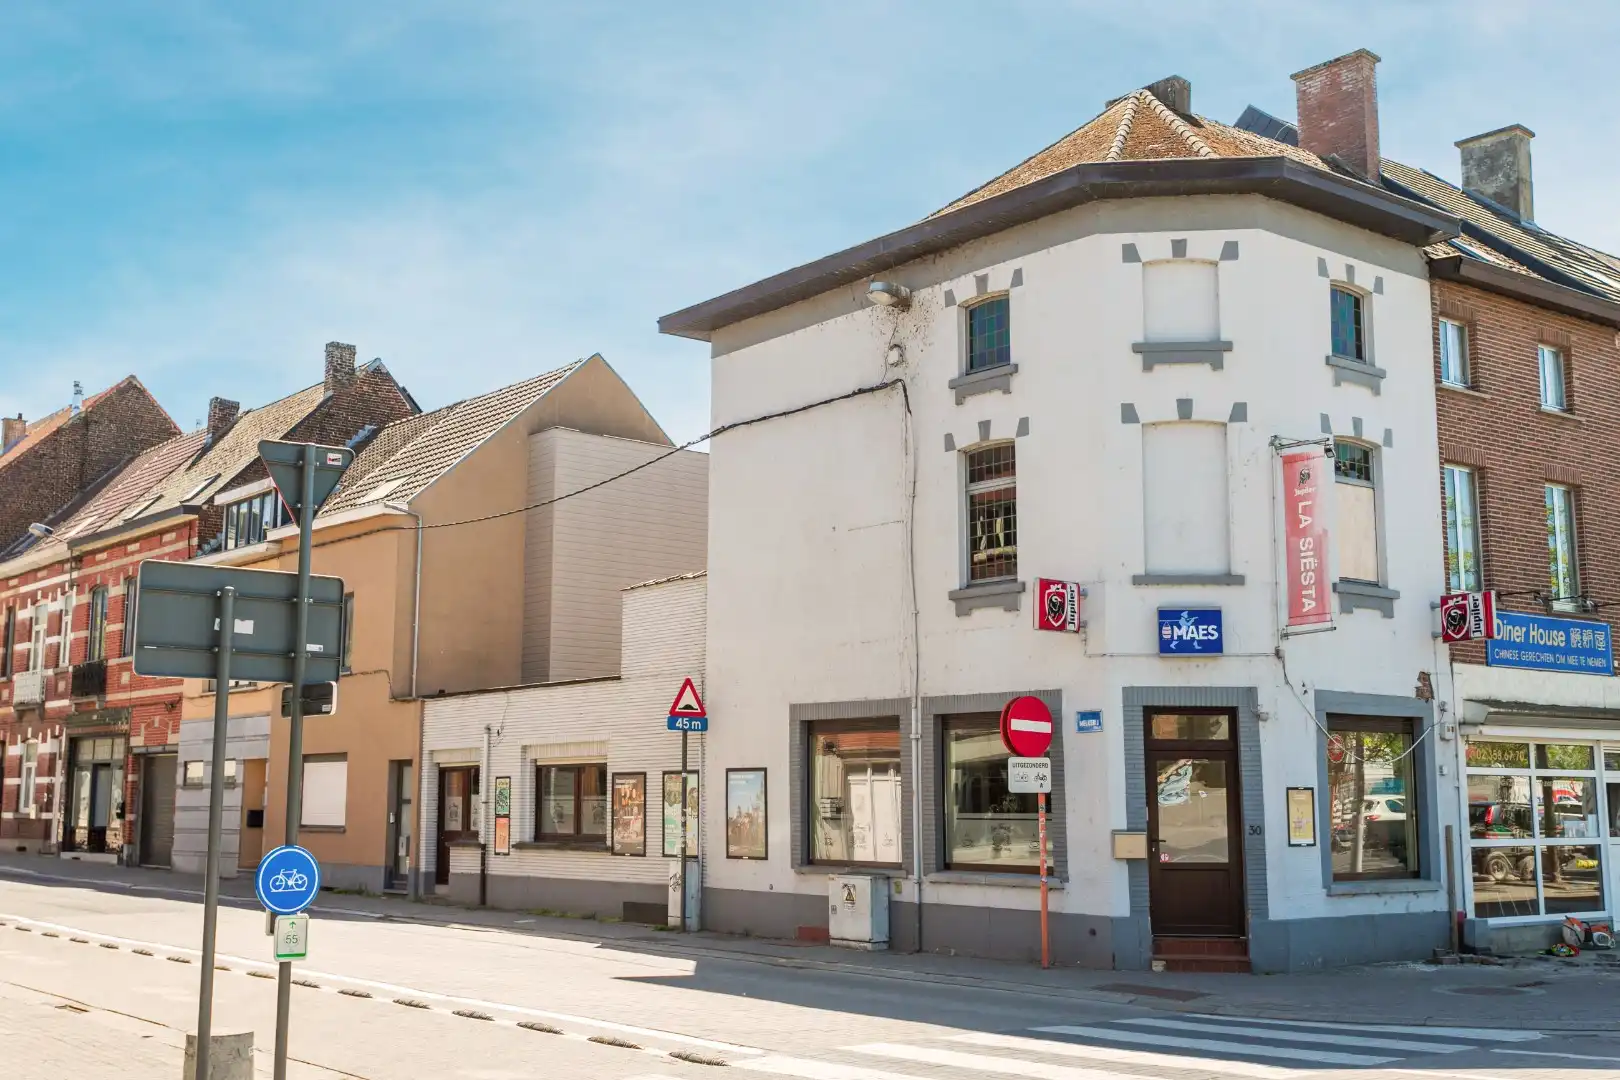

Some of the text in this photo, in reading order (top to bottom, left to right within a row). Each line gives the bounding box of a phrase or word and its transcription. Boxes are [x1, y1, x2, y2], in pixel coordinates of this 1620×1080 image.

[1298, 501, 1317, 612] LA SIËSTA
[1068, 585, 1077, 625] Jupiler
[1472, 596, 1483, 636] Jupiler
[1173, 625, 1219, 640] MAES
[1495, 618, 1566, 647] Diner House
[1494, 648, 1519, 661] CHINESE
[1520, 650, 1555, 664] GERECHTEN
[1555, 654, 1566, 665] OM
[1579, 656, 1586, 666] TE
[675, 717, 702, 730] 45 m
[1248, 824, 1262, 836] 30
[285, 934, 299, 945] 55
